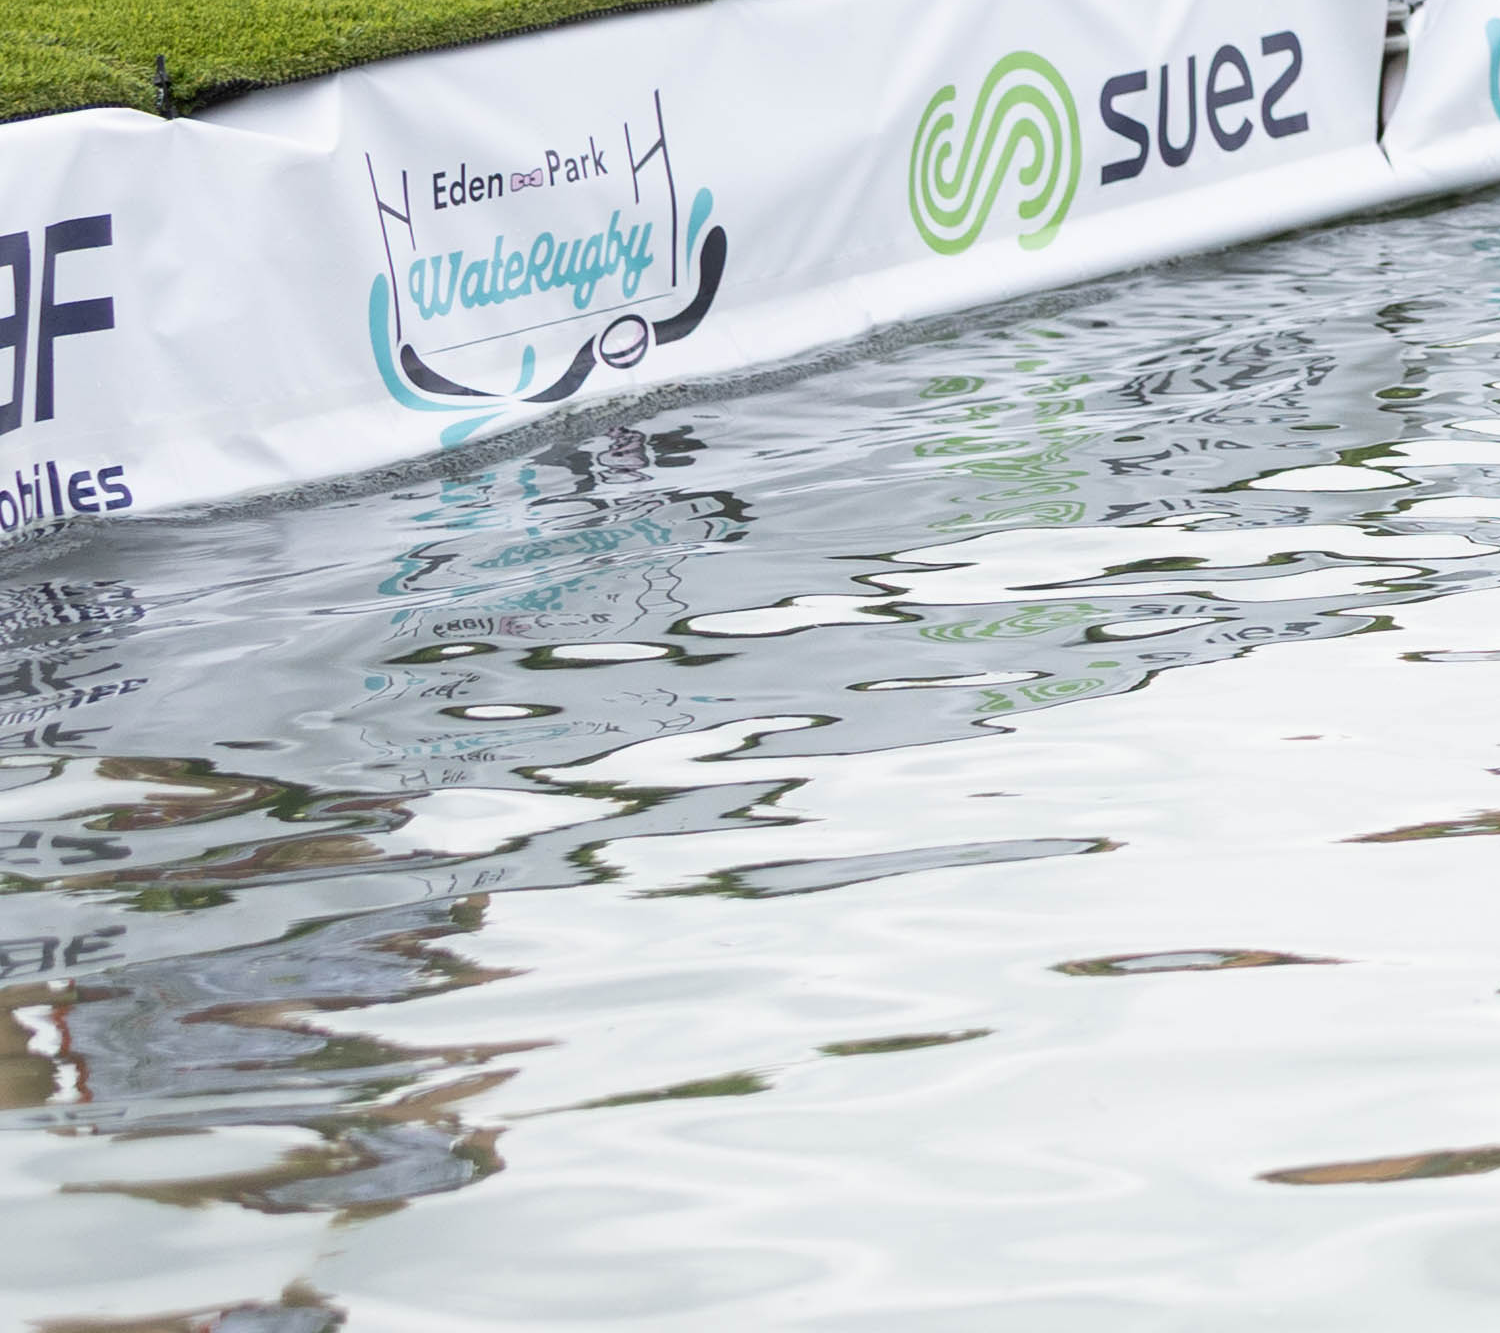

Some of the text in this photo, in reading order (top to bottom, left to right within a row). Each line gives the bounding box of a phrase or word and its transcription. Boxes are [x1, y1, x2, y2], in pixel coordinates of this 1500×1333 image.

[1101, 31, 1310, 186] suez
[433, 135, 609, 211] Eden Park
[408, 209, 654, 321] WateRugby
